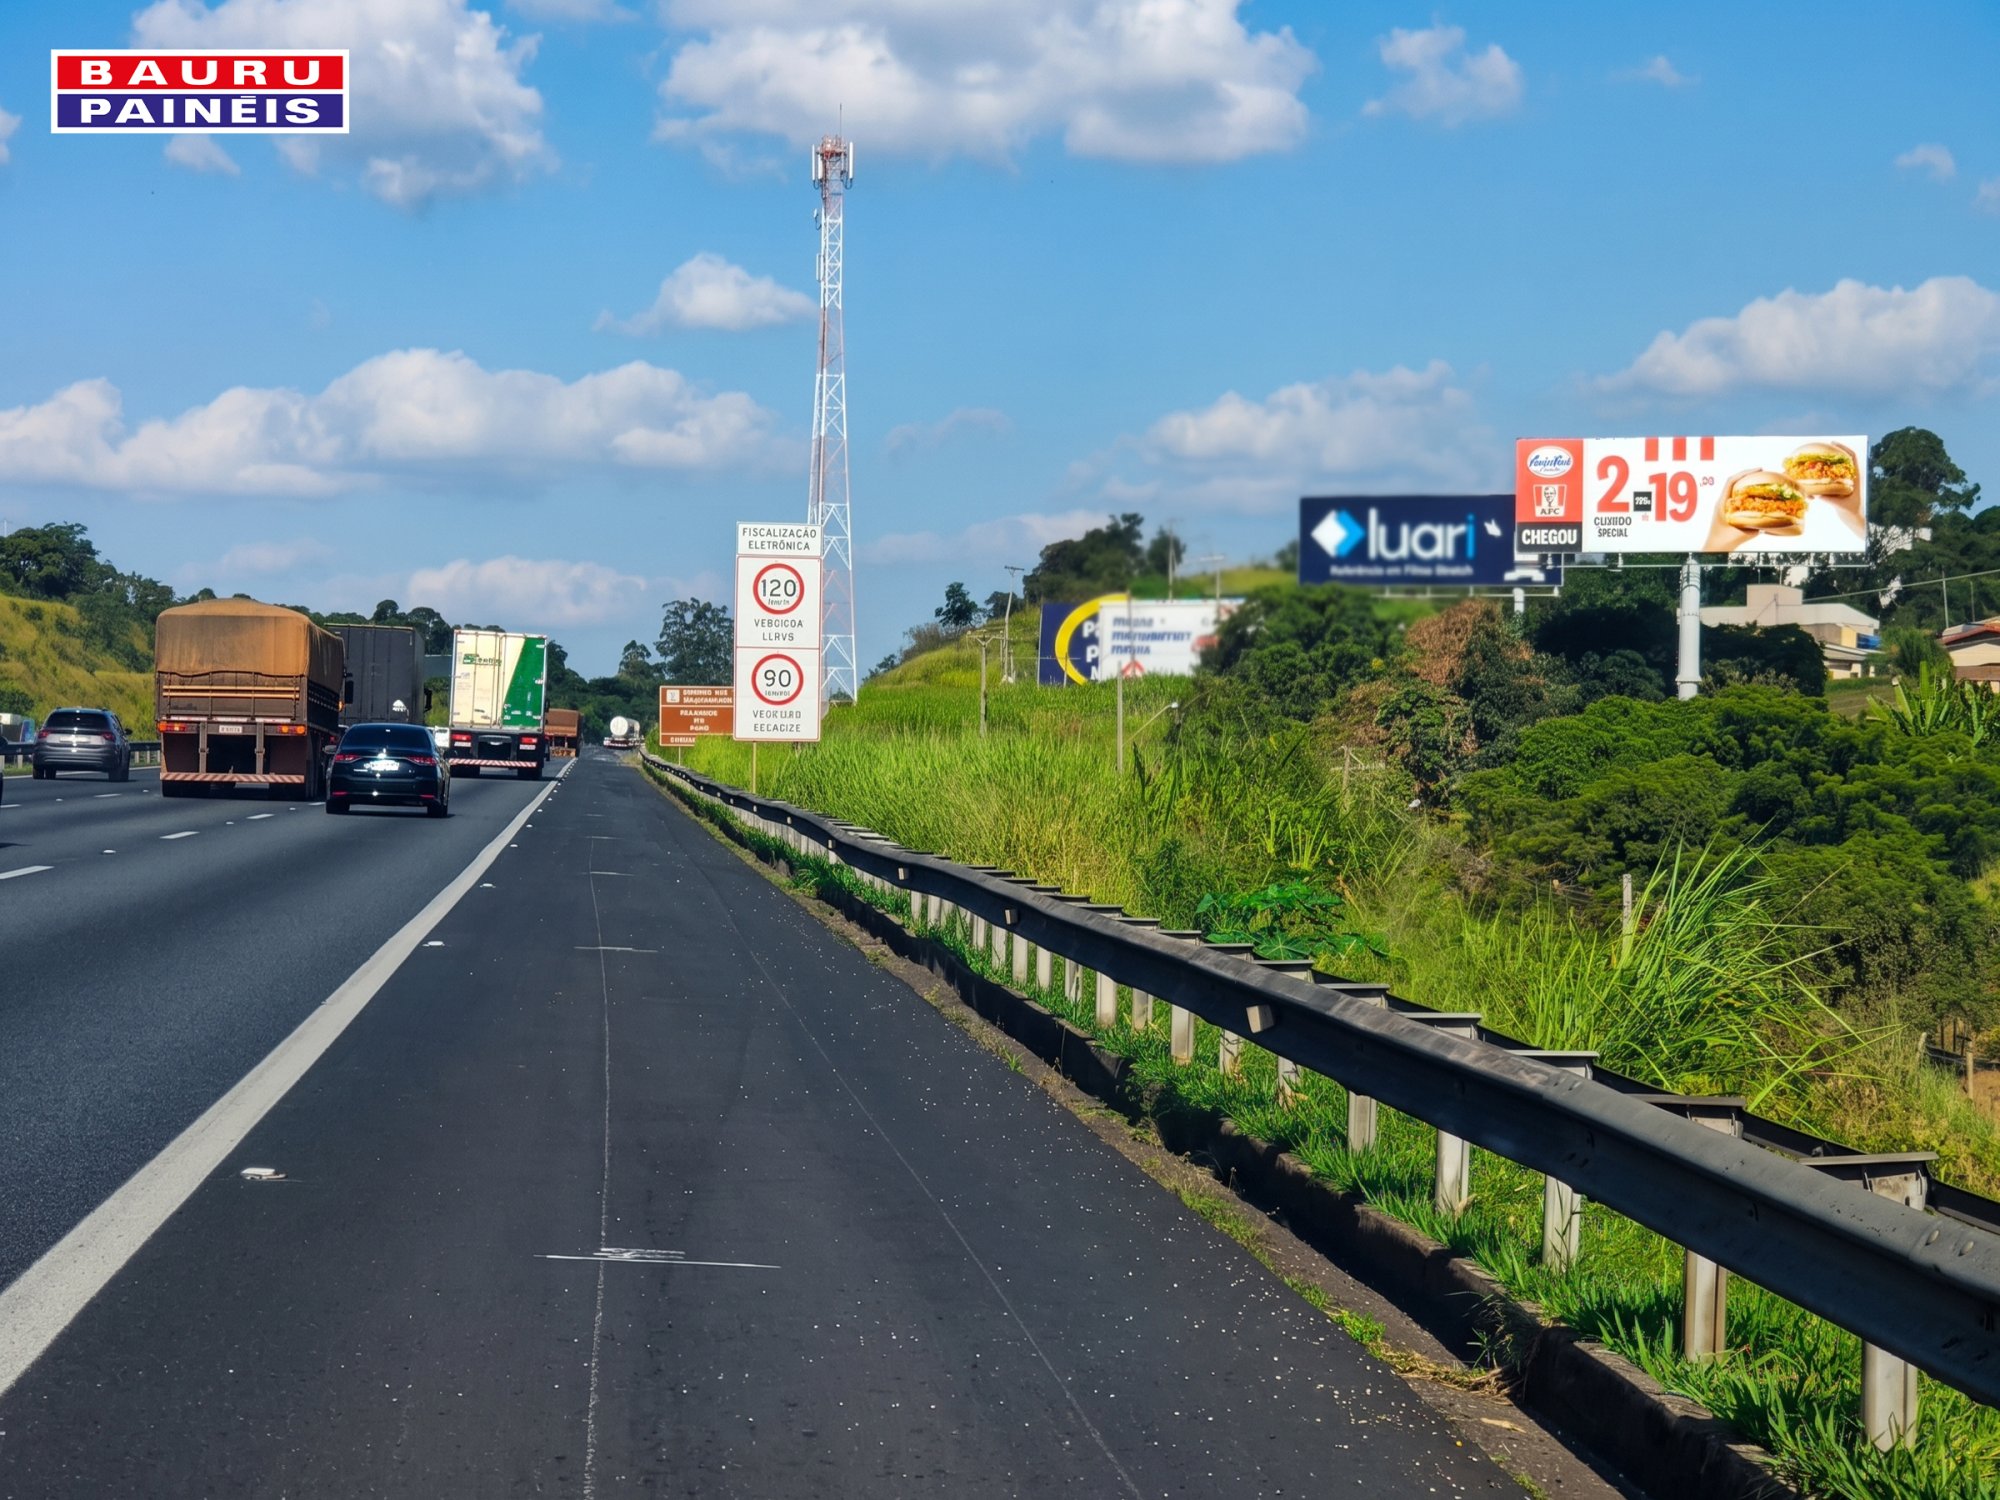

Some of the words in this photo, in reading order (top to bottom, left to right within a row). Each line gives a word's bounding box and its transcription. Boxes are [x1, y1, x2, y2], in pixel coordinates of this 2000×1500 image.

[1368, 507, 1476, 561] luari
[1521, 528, 1577, 545] CHEGOU
[760, 578, 797, 597] 120
[763, 669, 792, 688] 90
